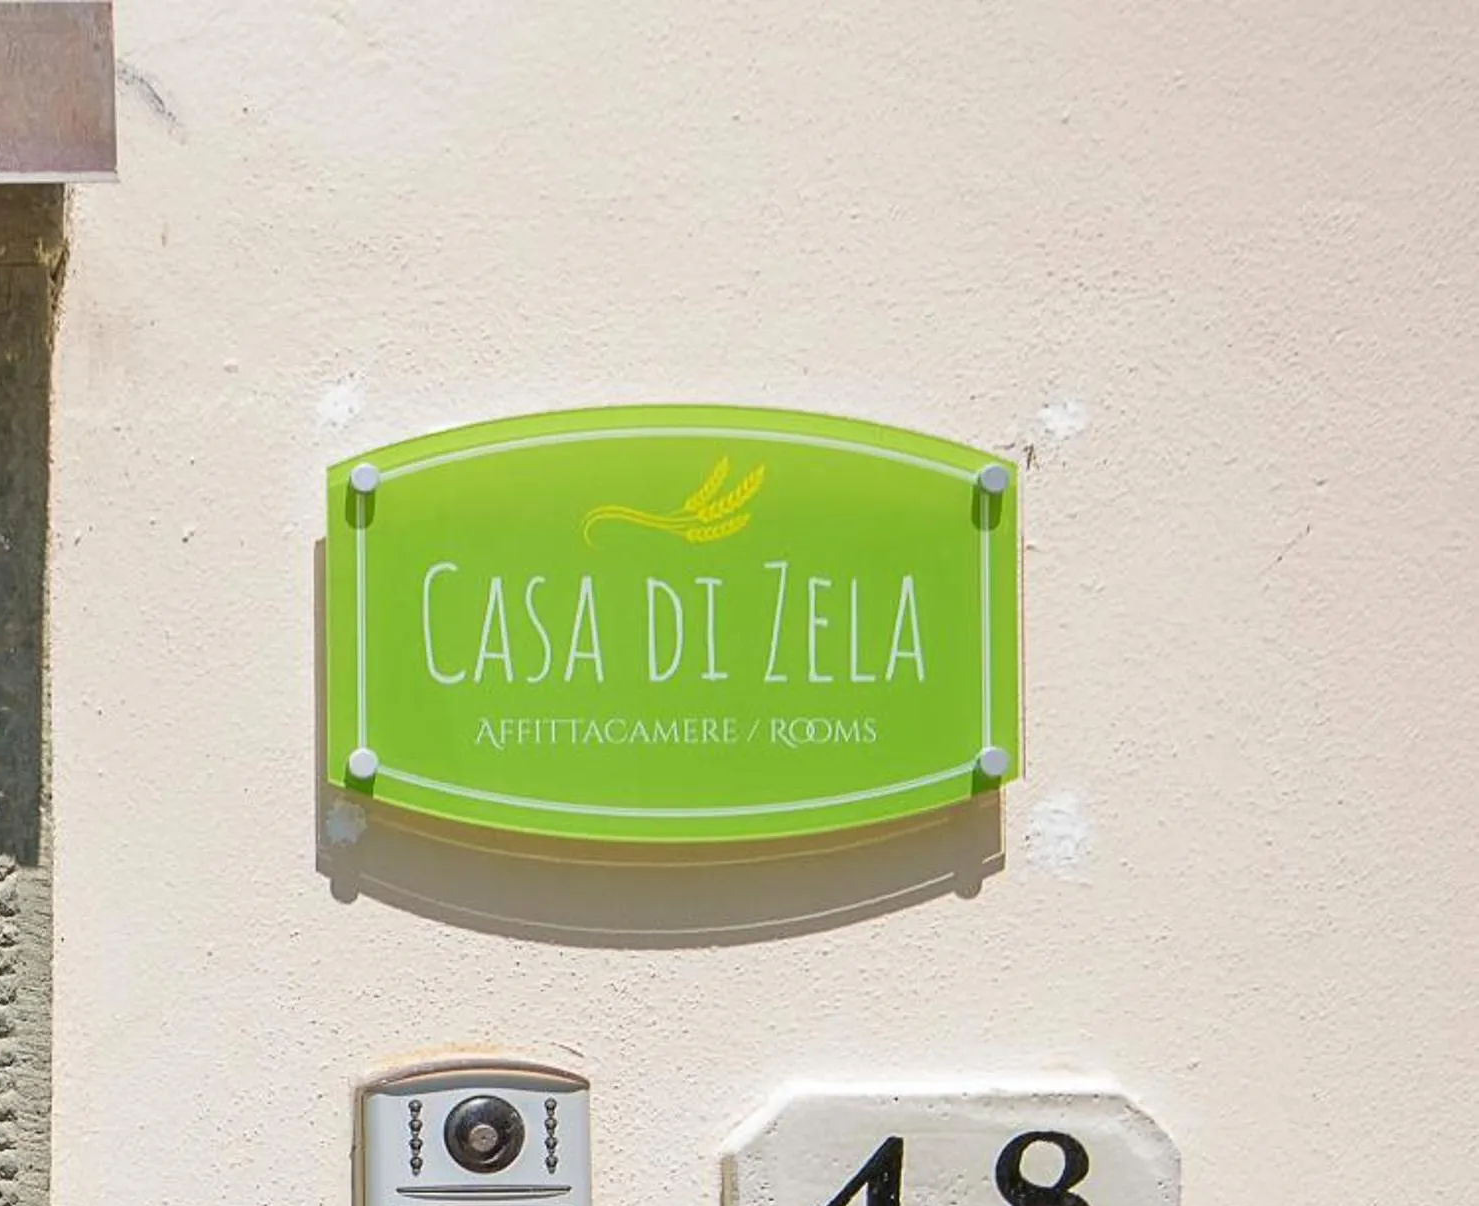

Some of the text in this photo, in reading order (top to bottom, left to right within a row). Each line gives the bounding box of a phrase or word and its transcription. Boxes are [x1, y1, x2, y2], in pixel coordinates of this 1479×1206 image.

[423, 560, 925, 686] CASA DI ZELA
[474, 717, 737, 749] AFFITTACAMERE
[769, 717, 878, 748] ROOMS
